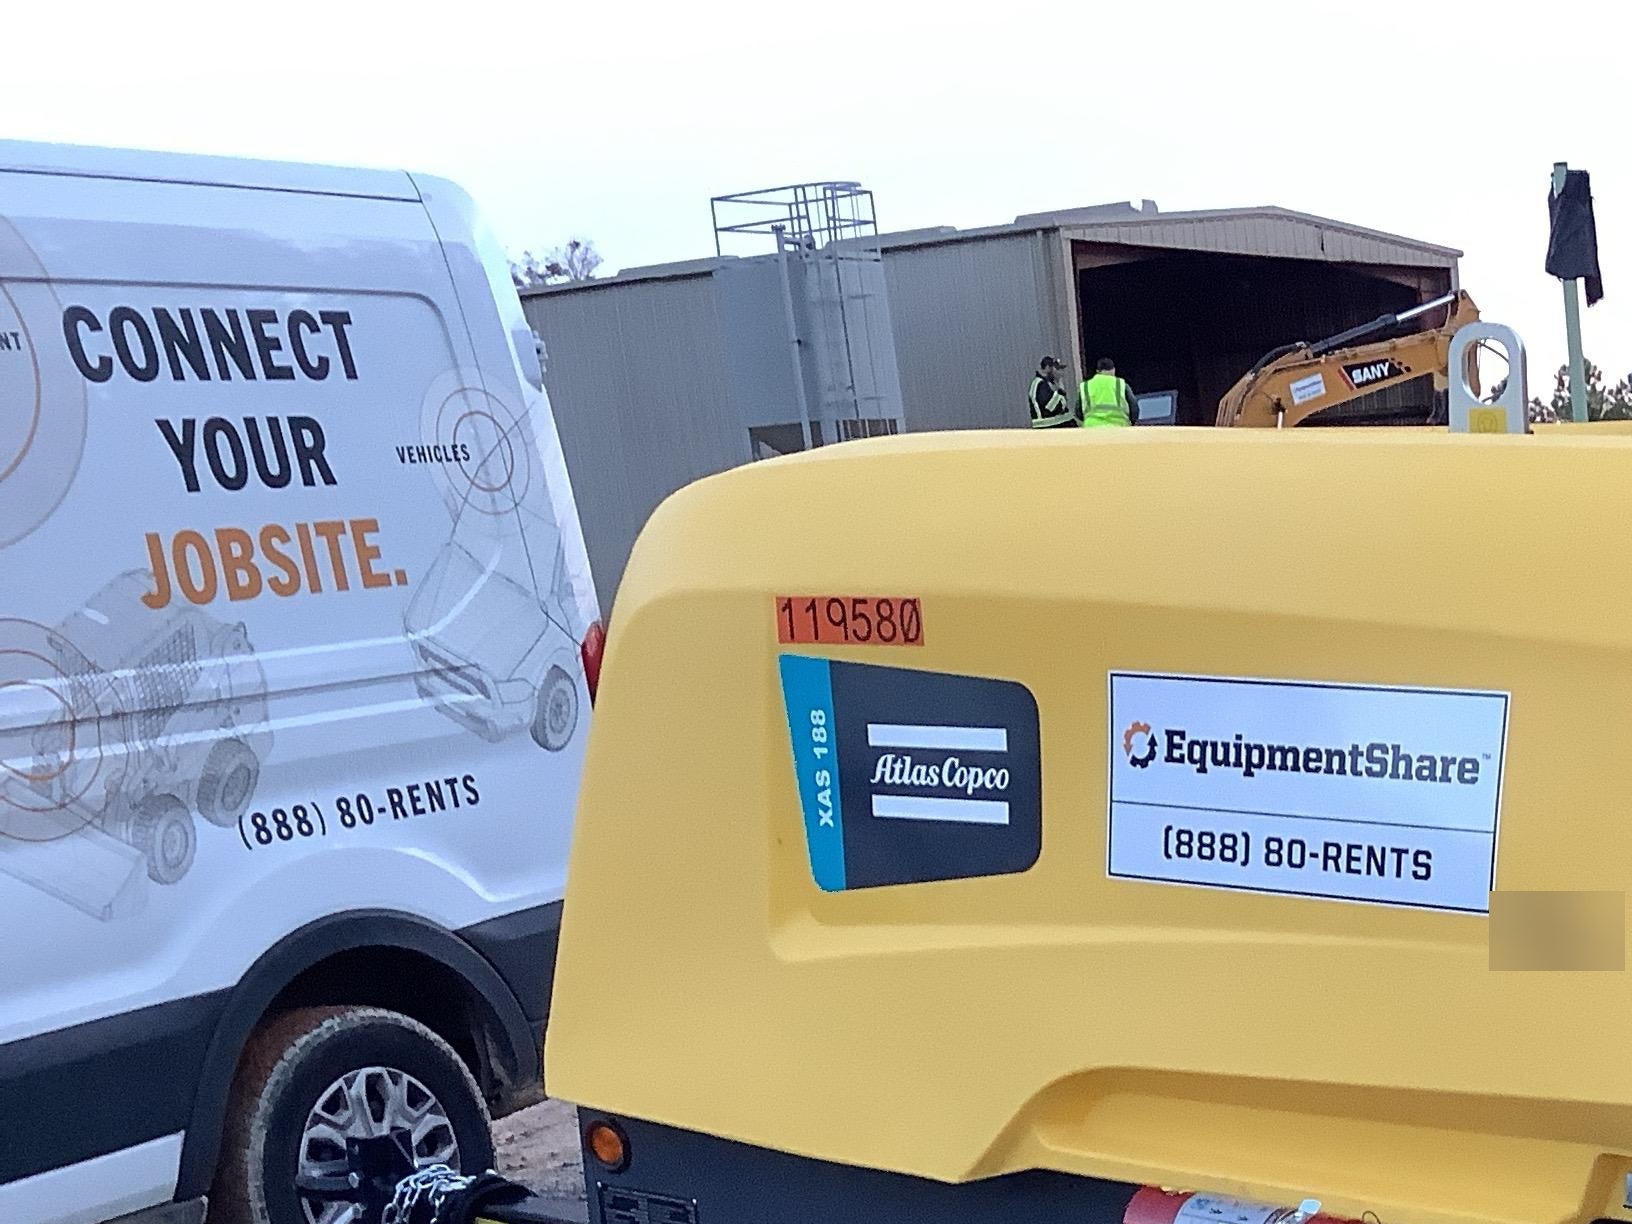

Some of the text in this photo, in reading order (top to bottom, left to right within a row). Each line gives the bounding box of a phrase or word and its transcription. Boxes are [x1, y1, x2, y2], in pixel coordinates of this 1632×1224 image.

[62, 305, 359, 383] CONNECT
[1351, 361, 1390, 384] SANY
[154, 415, 338, 493] YOUR
[395, 443, 471, 465] VEHICLES
[140, 517, 408, 610] JOBSITE.
[809, 708, 835, 827] XAS 188
[1163, 728, 1481, 785] EquipmentShare
[239, 774, 481, 851] (888) 80-RENTS
[1162, 824, 1433, 882] (888) 80-RENTS
